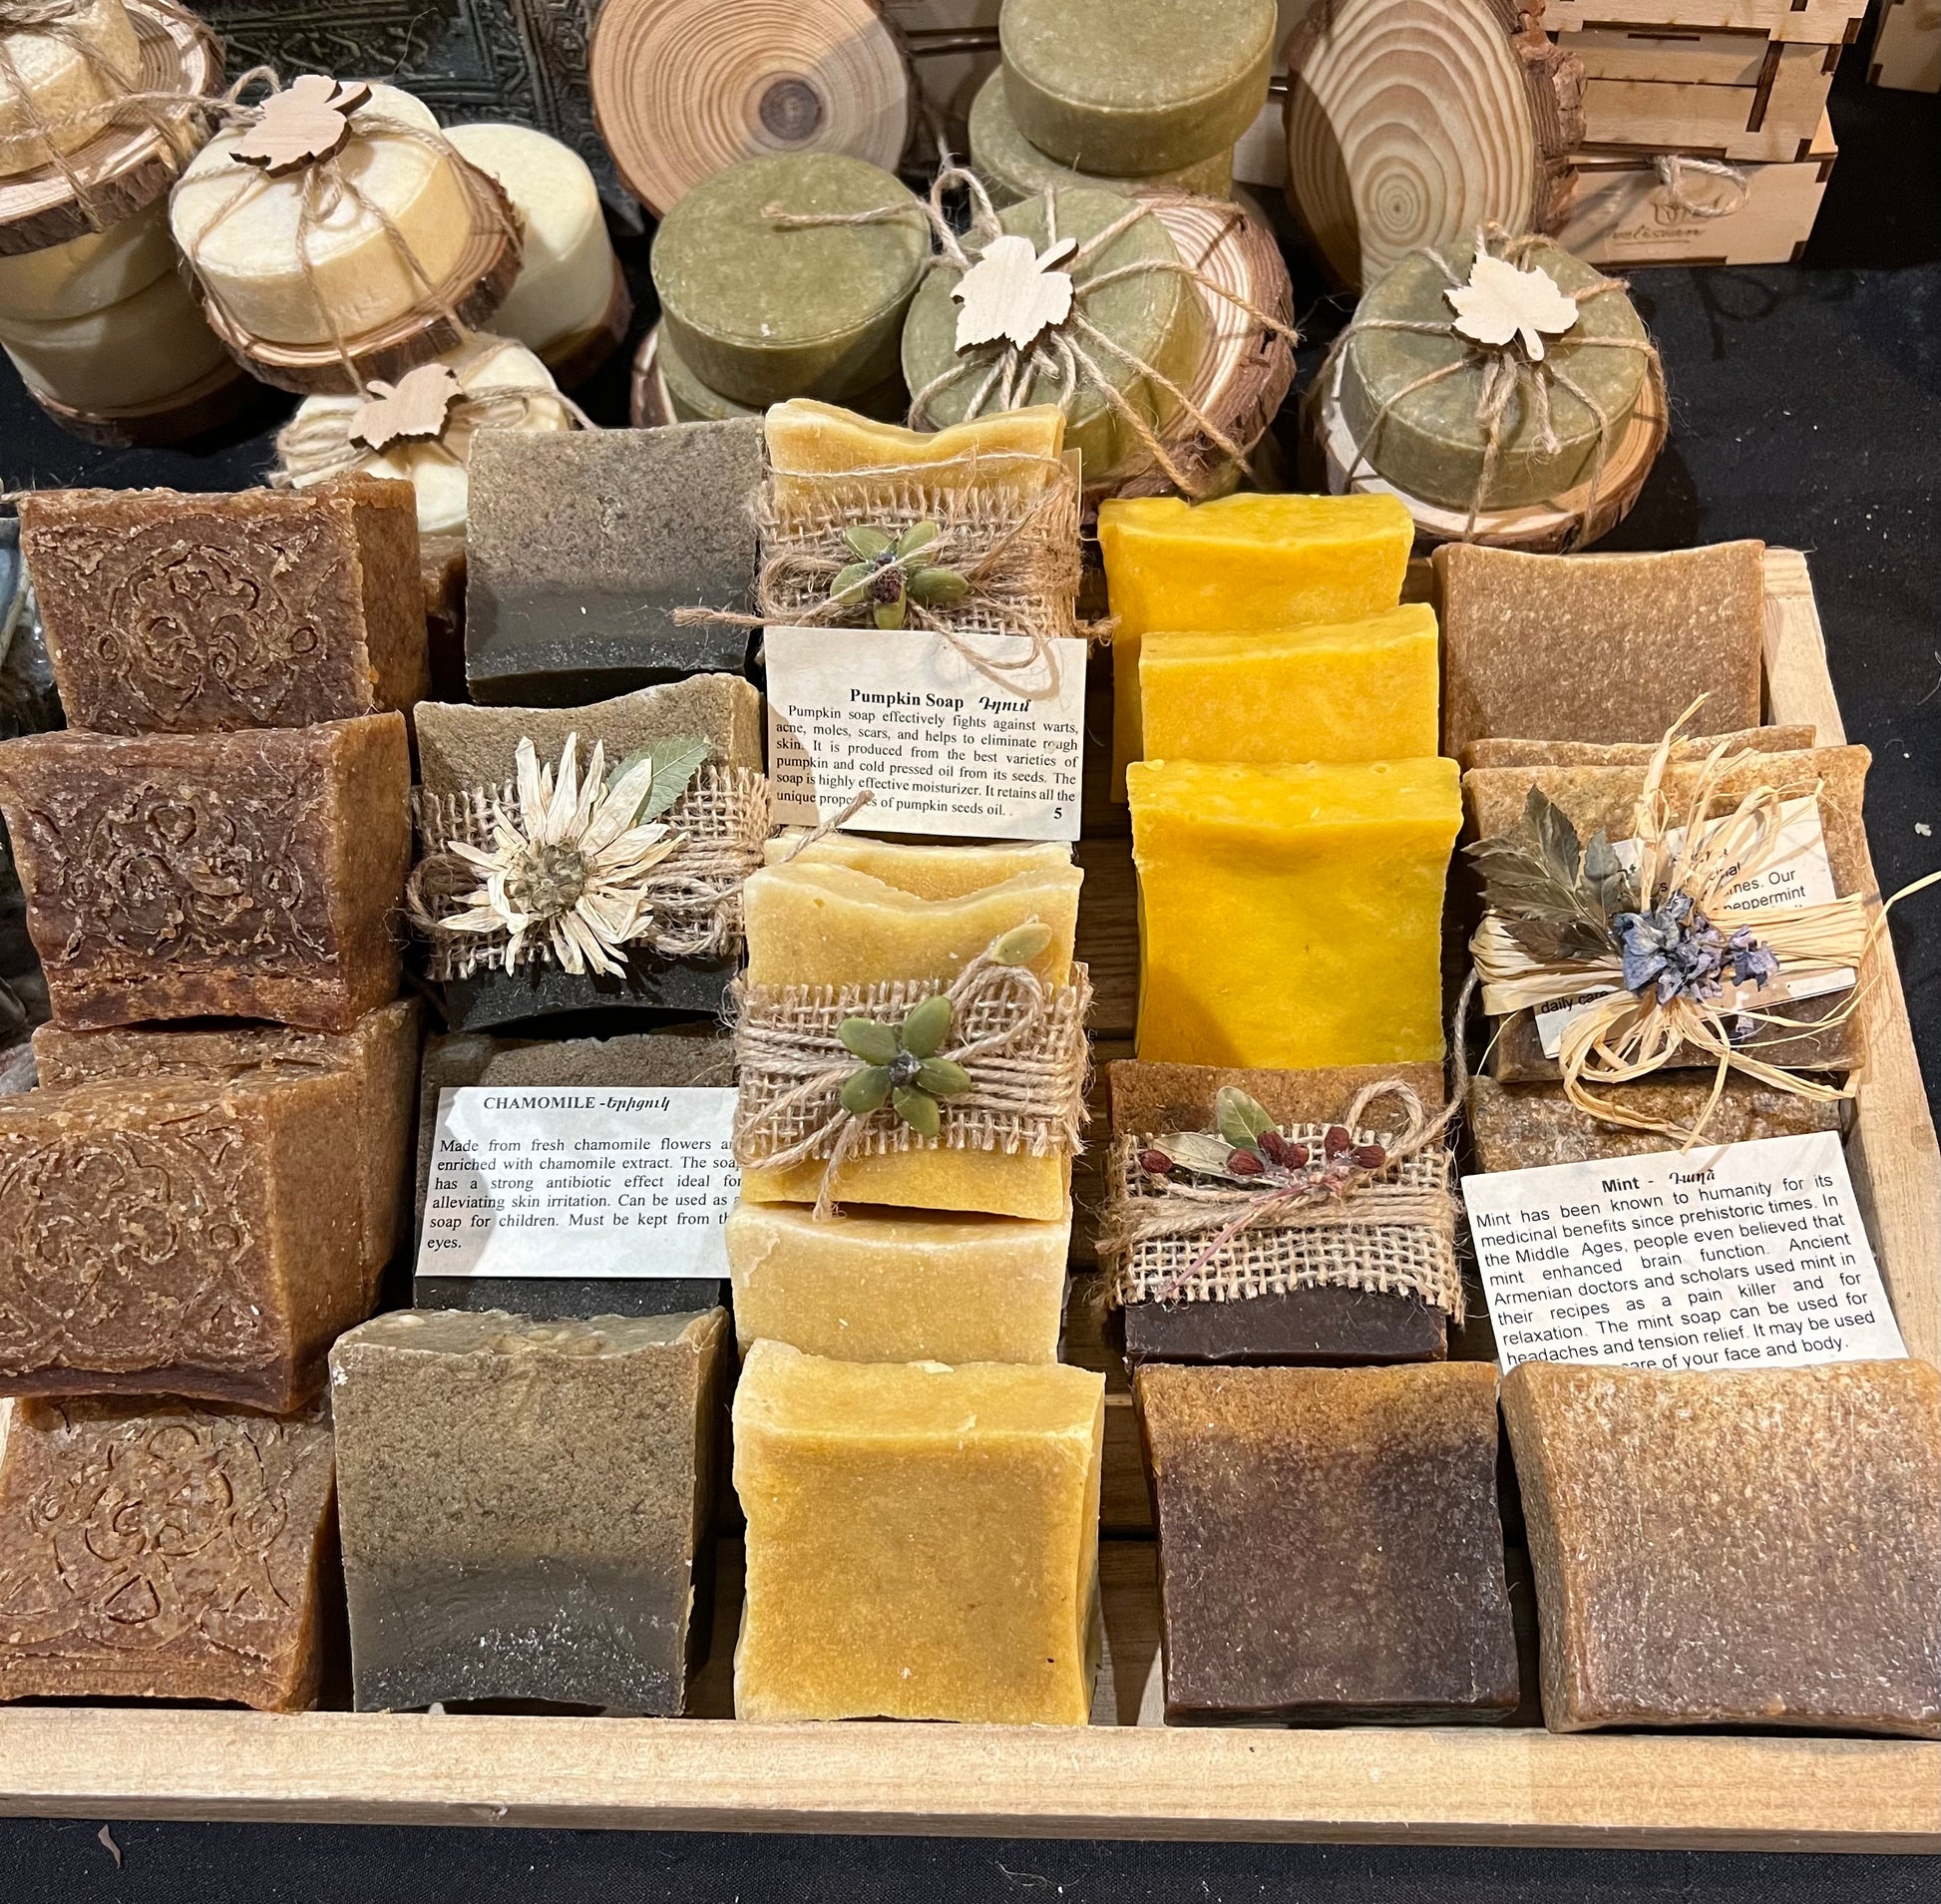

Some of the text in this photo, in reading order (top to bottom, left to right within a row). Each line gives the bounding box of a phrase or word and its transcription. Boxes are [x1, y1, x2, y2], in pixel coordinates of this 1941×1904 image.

[850, 687, 921, 708] Pumpkin
[926, 693, 965, 711] Soap
[788, 705, 1078, 734] Pumpkin soap effectively fights against warts,
[776, 724, 806, 738] acne,
[813, 724, 852, 738] moles,
[858, 728, 891, 740] scars,
[897, 729, 919, 741] and
[926, 729, 957, 746] helps
[964, 734, 974, 744] to
[980, 733, 1036, 748] eliminate
[777, 737, 1077, 767] skin. It is produced from the best varieties of
[777, 756, 1076, 785] pumpkin and cold pressed oil from its seeds. The
[776, 772, 1075, 802] soap is highly effective moisturizer. It retains all the
[776, 790, 816, 805] unique
[881, 796, 895, 808] of
[896, 799, 948, 814] pumpkin
[952, 802, 983, 815] seeds
[1053, 807, 1062, 820] 5
[1768, 870, 1795, 885] Our
[1541, 997, 1573, 1013] daily
[484, 1096, 595, 1109] CHAMOMILE
[440, 1139, 479, 1152] Made
[488, 1139, 521, 1152] from
[531, 1138, 565, 1151] fresh
[574, 1137, 650, 1151] chamomile
[660, 1137, 711, 1150] flowers
[438, 1156, 707, 1171] enriched with chamomile extract. The
[435, 1174, 710, 1192] has a strong antibiotic effect ideal
[1601, 1177, 1640, 1193] Mint
[432, 1195, 505, 1211] alleviating
[512, 1195, 540, 1208] skin
[547, 1194, 610, 1207] irritation.
[617, 1194, 645, 1207] Can
[652, 1193, 669, 1206] be
[675, 1193, 706, 1206] used
[712, 1196, 727, 1206] as
[1476, 1174, 1833, 1228] Mint has been known to humanity for its
[430, 1212, 709, 1231] soap for children. Must be kept from
[1481, 1194, 1838, 1247] medicinal benefits since prehistoric times. In
[427, 1238, 462, 1251] eyes.
[1485, 1213, 1845, 1267] the Middle Ages, people even believed that
[1490, 1232, 1851, 1286] mint enhanced brain function. Ancient
[1495, 1252, 1856, 1306] Armenian doctors and scholars used mint in
[1498, 1273, 1861, 1326] their recipes as a pain killer and for
[1503, 1292, 1867, 1345] relaxation. The mint soap can be used for
[1603, 1337, 1635, 1354] and
[1638, 1333, 1700, 1350] tension
[1703, 1325, 1749, 1342] relief.
[1752, 1324, 1766, 1337] It
[1768, 1322, 1802, 1335] may
[1807, 1318, 1830, 1331] be
[1833, 1310, 1875, 1328] used
[1662, 1334, 1850, 1368] of your face and body.
